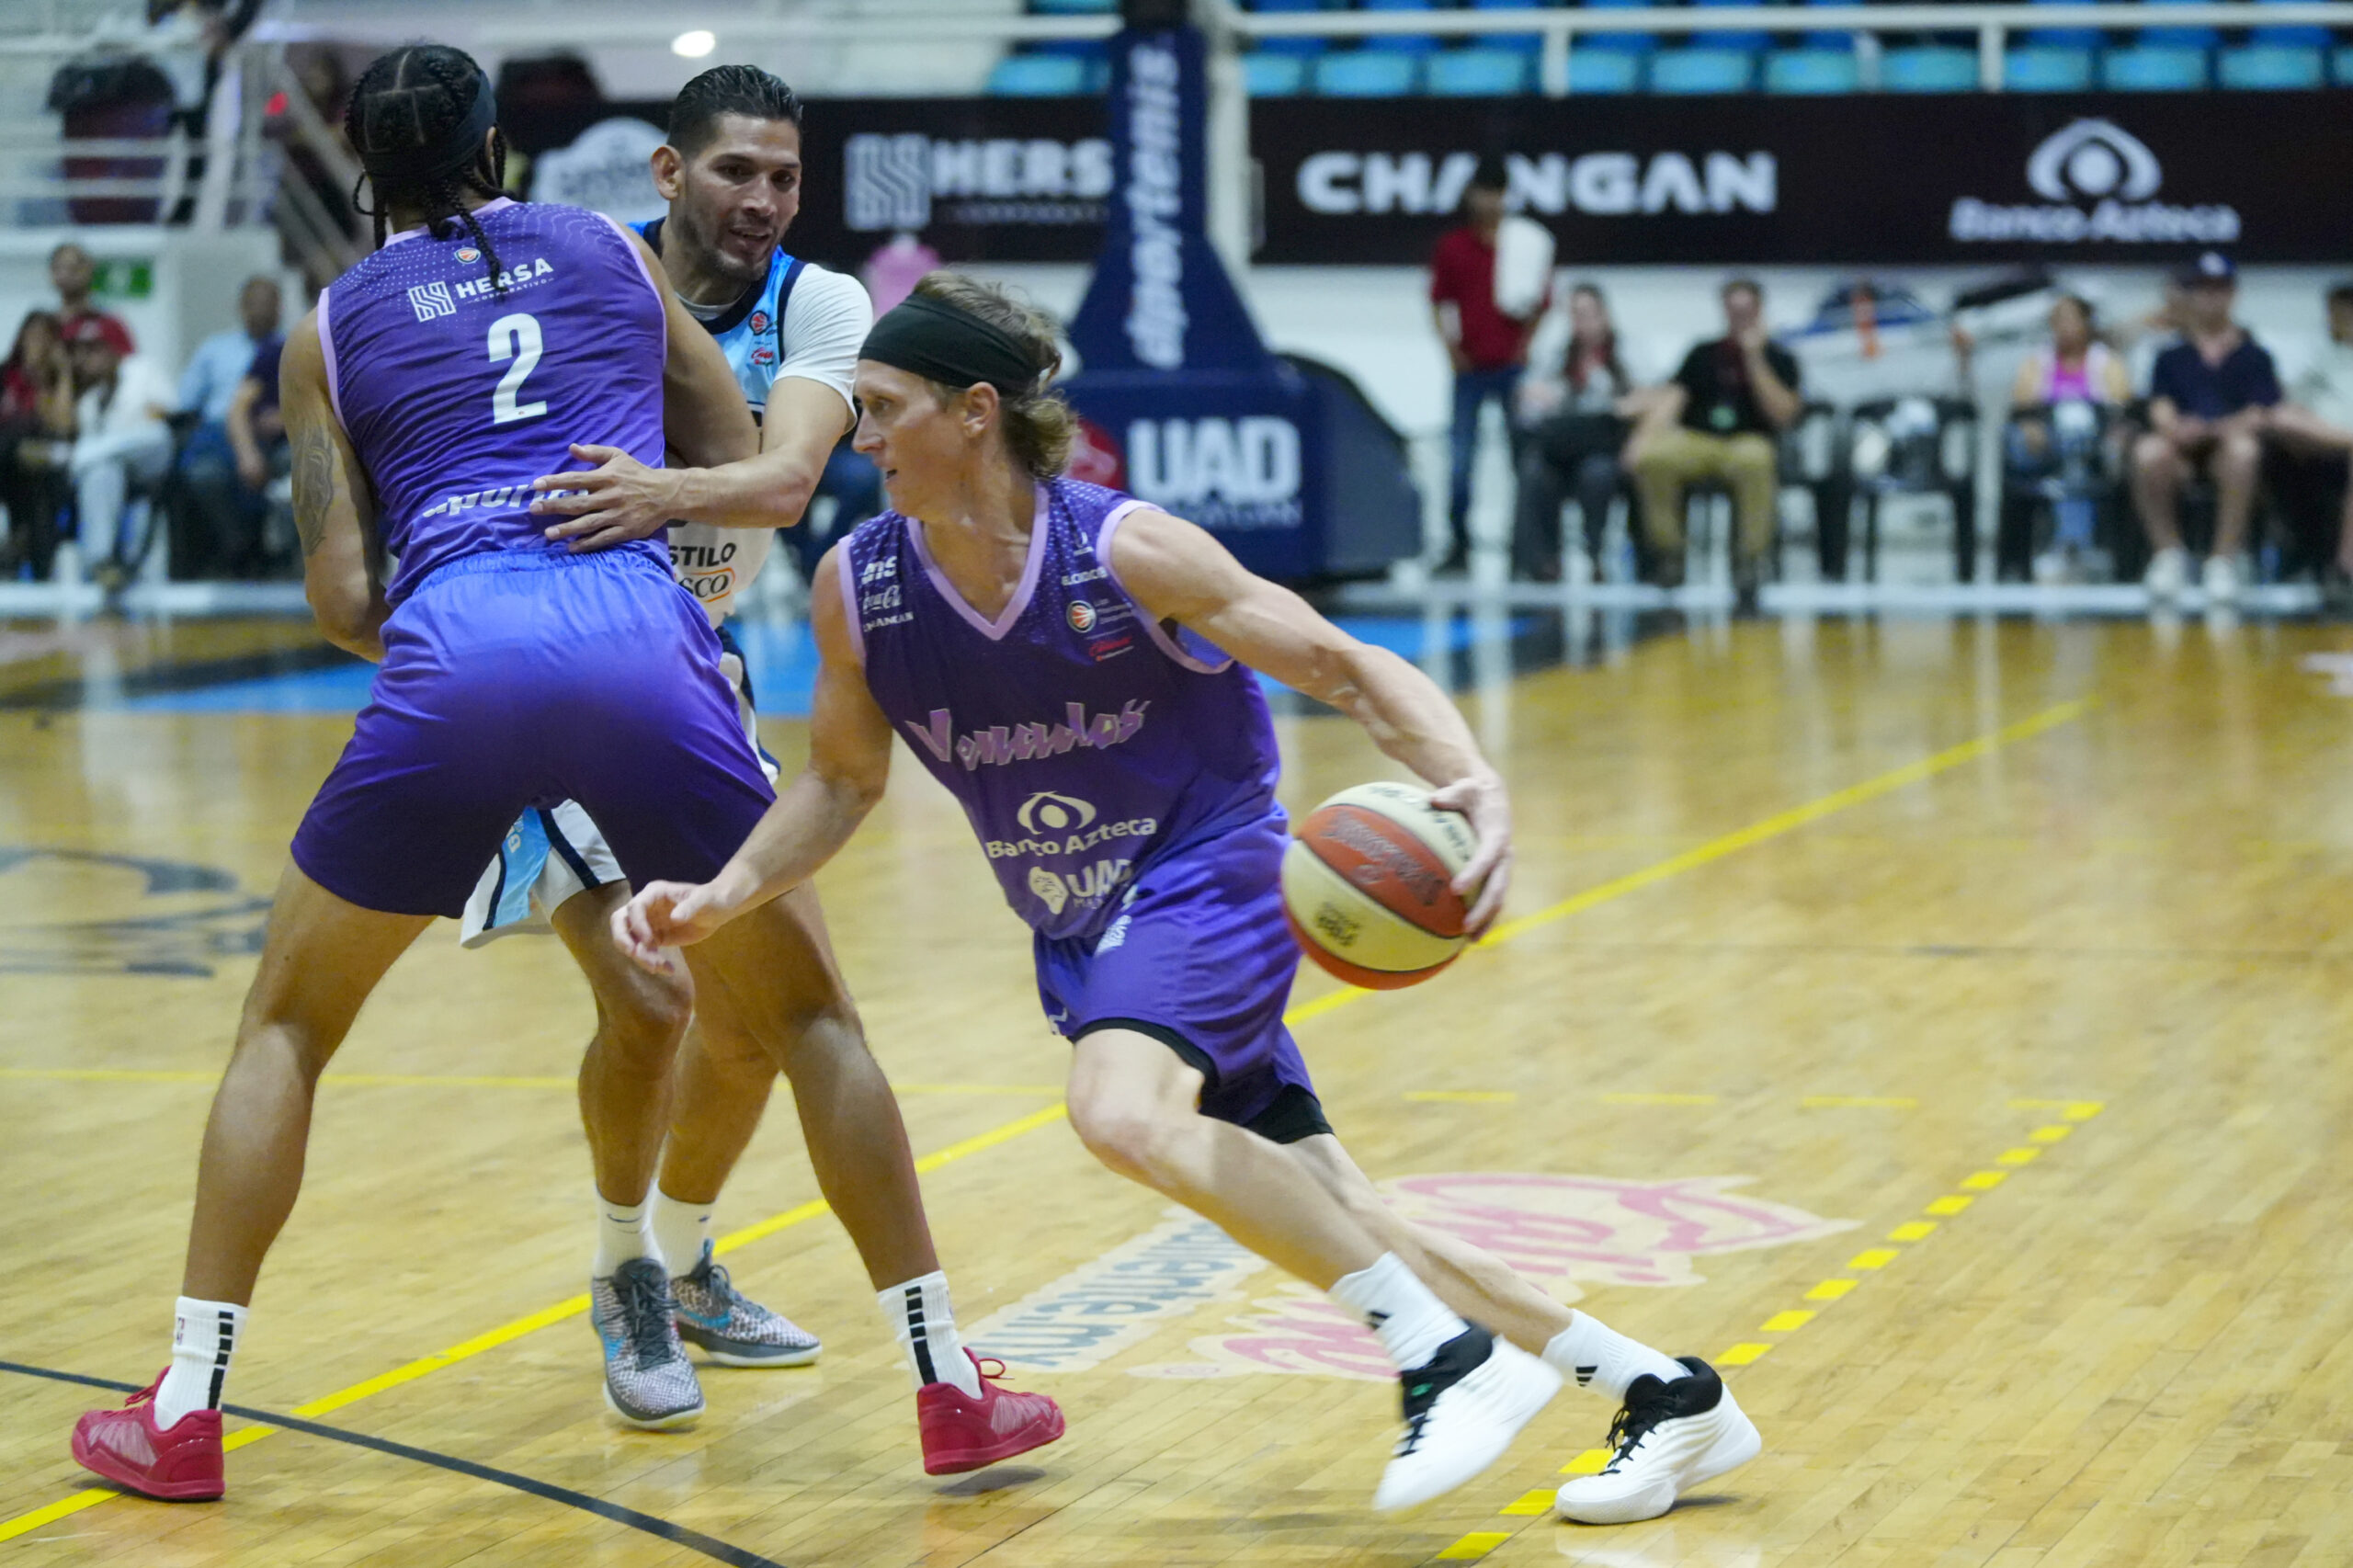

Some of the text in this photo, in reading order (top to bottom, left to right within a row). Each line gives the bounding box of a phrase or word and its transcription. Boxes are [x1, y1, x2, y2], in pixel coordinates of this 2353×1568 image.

[929, 139, 1113, 198] HERS
[1949, 197, 2241, 243] Banco Azteca
[456, 258, 553, 299] HERSA
[473, 278, 547, 302] CORPRATIVO
[487, 312, 547, 424] 2
[1127, 415, 1302, 502] UAD
[668, 542, 736, 567] STILO
[985, 817, 1157, 858] Banco Azteca
